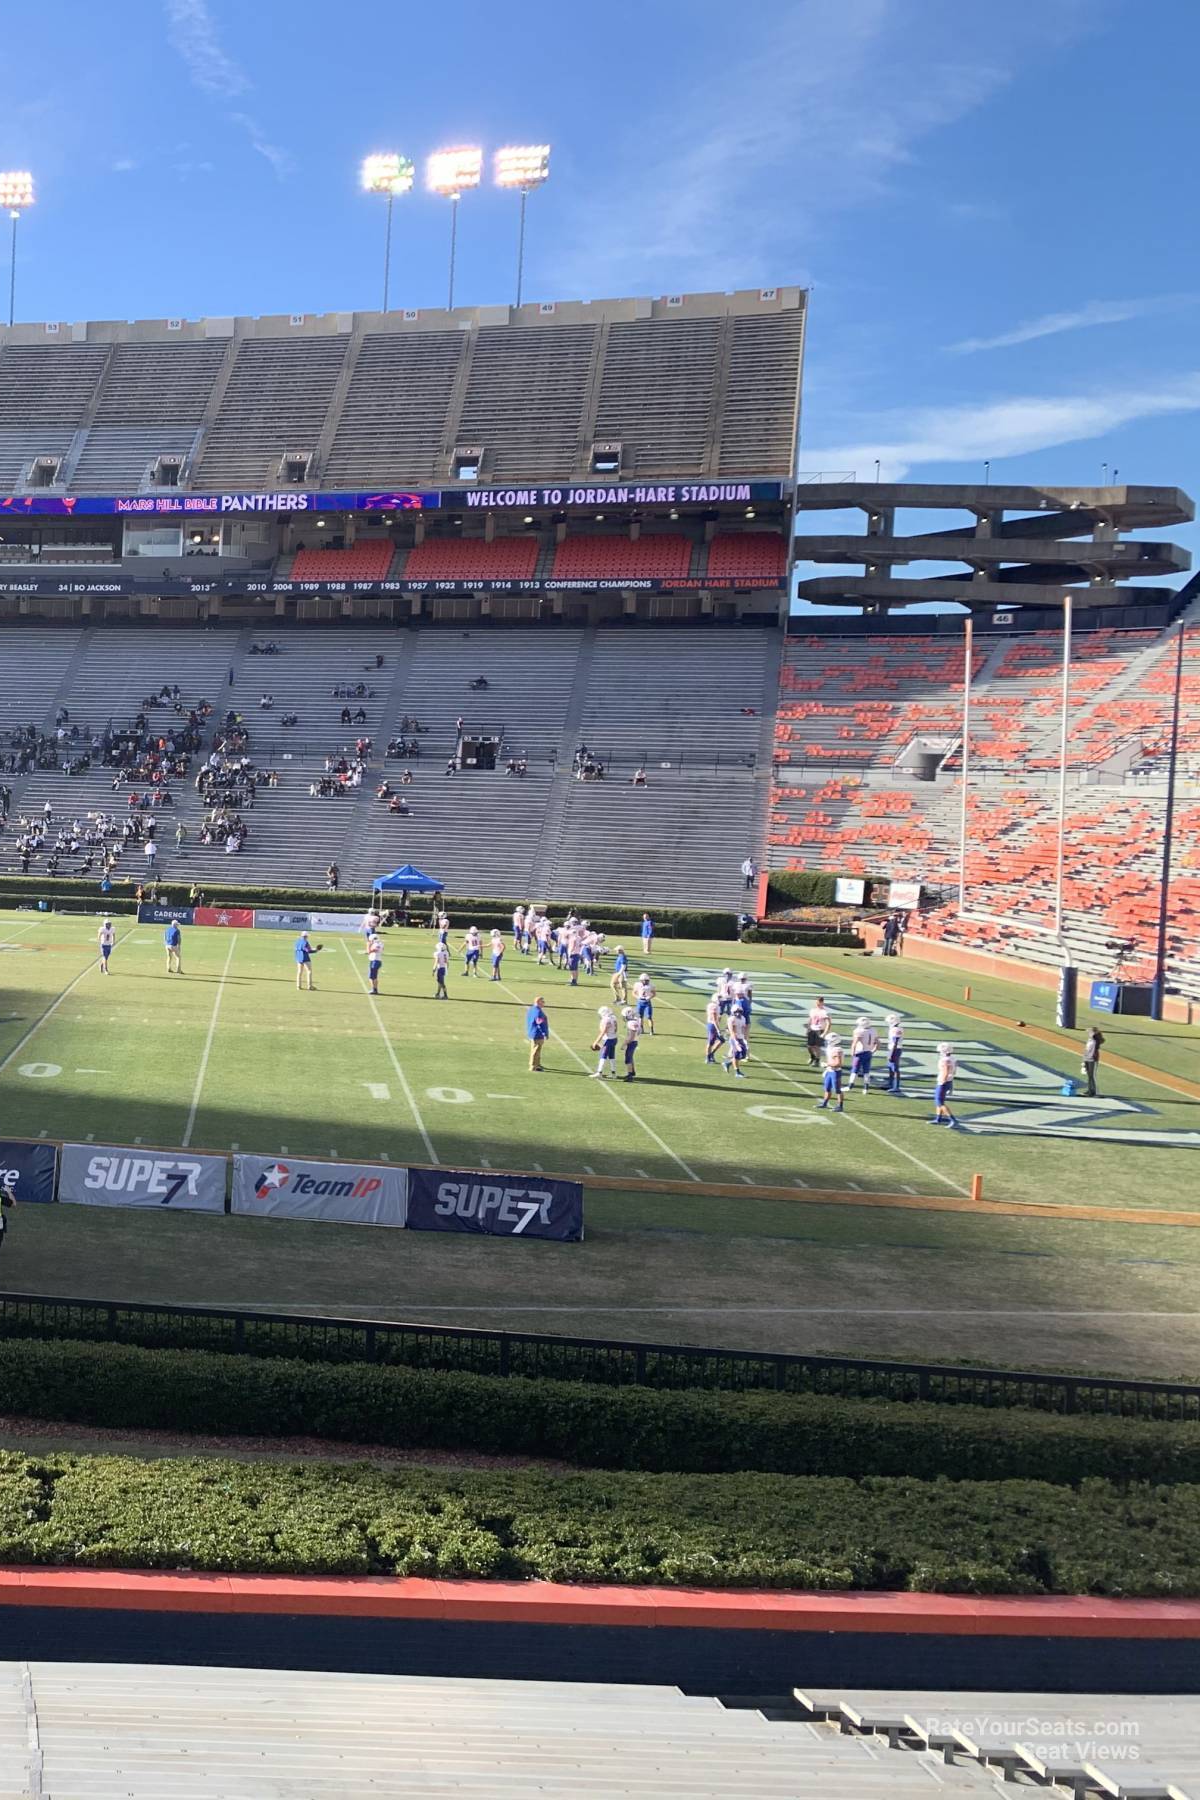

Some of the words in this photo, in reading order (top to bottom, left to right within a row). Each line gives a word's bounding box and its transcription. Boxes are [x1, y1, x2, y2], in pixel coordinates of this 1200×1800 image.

[762, 290, 774, 298] 47
[467, 489, 537, 507] WELCOME
[542, 489, 560, 505] TO
[566, 486, 675, 505] JORDAN-HARE
[681, 484, 751, 502] STADIUM
[118, 499, 154, 511] MARS
[156, 499, 182, 511] HILL
[185, 498, 217, 511] BIBLE
[221, 495, 308, 512] PANTHERS
[9, 583, 39, 592] BEASLEY
[58, 583, 68, 592] 34
[74, 584, 85, 592] BO
[86, 584, 121, 593] JACKSON
[190, 584, 210, 592] 2013
[247, 583, 266, 591] 2010
[273, 583, 293, 591] 2004
[300, 583, 319, 591] 1989
[327, 583, 346, 591] 1988
[353, 583, 373, 591] 1987
[435, 582, 455, 590] 1932
[463, 582, 483, 590] 1919
[491, 581, 511, 589] 1914
[519, 581, 540, 589] 1913
[544, 580, 598, 589] CONFERENCE
[599, 580, 652, 589] CHAMPIONS
[660, 579, 702, 589] JORDAN
[704, 579, 730, 588] HARE
[734, 578, 778, 588] STADIUM
[995, 615, 1010, 623] 46
[153, 910, 188, 920] CADENCE
[291, 1173, 383, 1199] TeamIP
